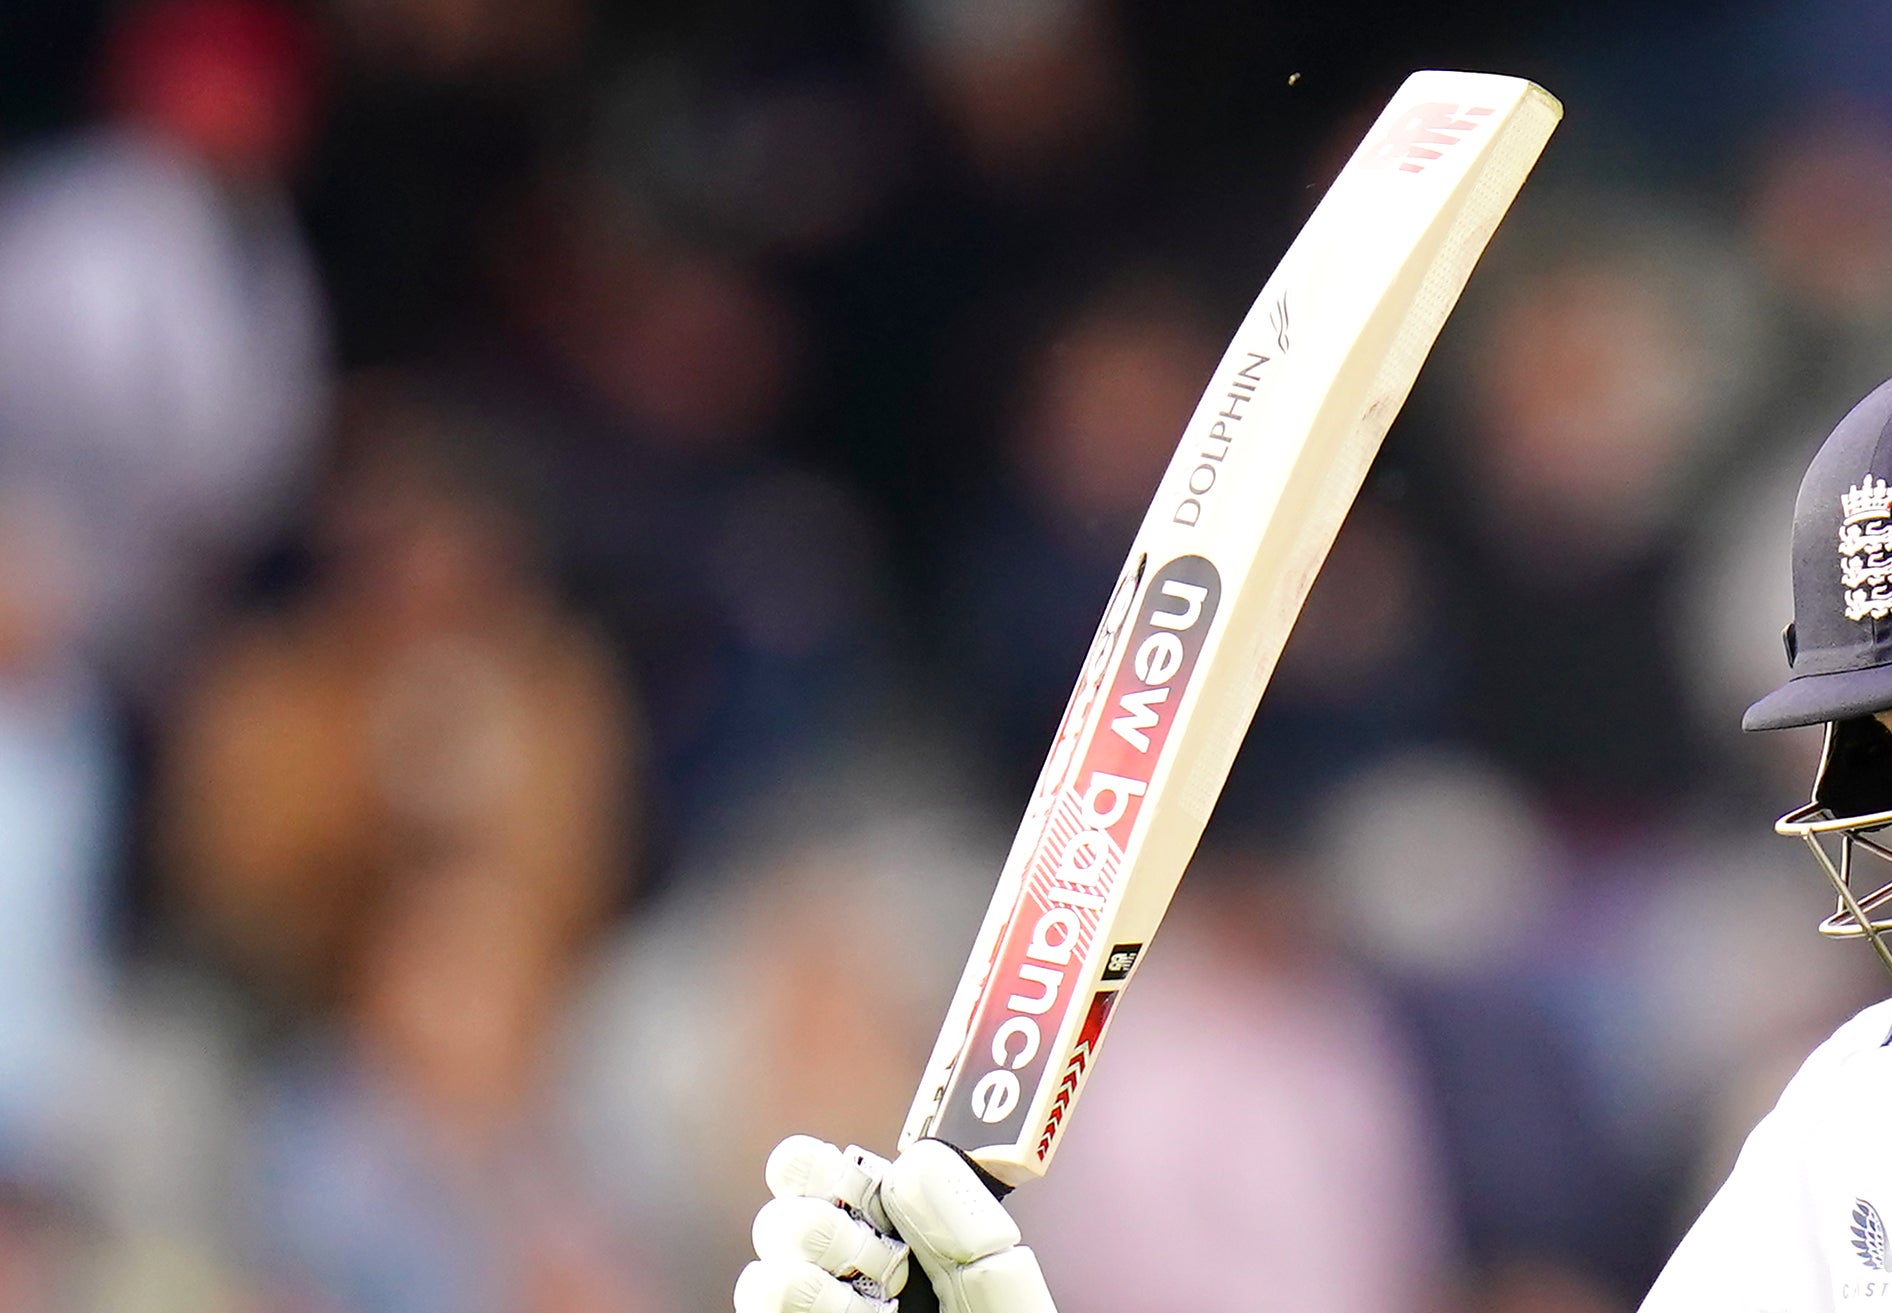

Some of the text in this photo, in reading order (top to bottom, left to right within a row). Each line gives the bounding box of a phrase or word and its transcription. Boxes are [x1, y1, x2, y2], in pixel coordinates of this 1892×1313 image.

[1173, 352, 1271, 528] DOLPHIN
[971, 580, 1208, 1124] new balance
